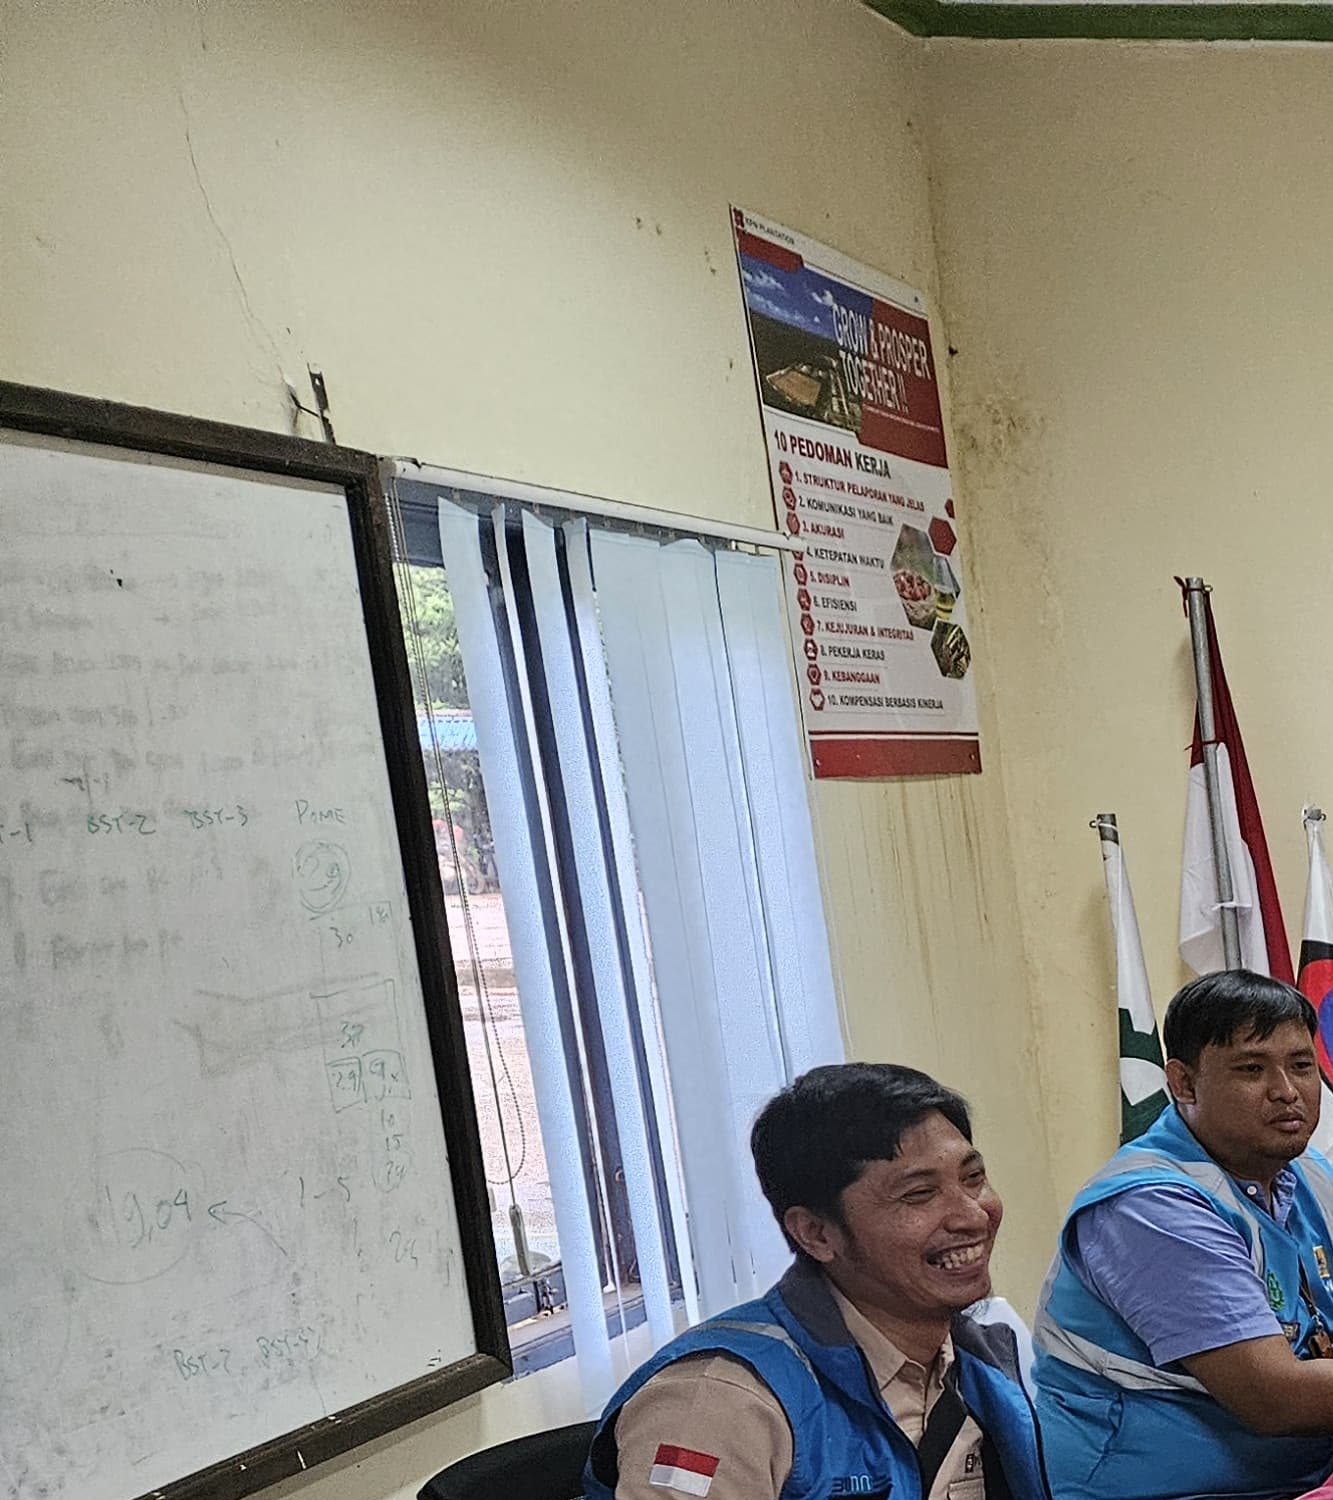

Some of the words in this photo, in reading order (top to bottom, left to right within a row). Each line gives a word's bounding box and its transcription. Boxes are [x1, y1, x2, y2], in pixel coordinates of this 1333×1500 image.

[832, 303, 868, 356] GROW
[878, 323, 932, 381] PROSPER
[839, 349, 902, 412] TOGETHER
[774, 429, 788, 452] 10
[790, 433, 853, 468] PEDOMAN
[854, 451, 892, 480] KERJA
[803, 472, 846, 492] STRUKTUR
[847, 482, 890, 503] PELAPORAN
[807, 497, 857, 517] KOMUNIKASI
[810, 522, 845, 540] AKURASI
[814, 547, 859, 564] KETEPATAN
[817, 572, 850, 587] DISIPLIN
[821, 596, 858, 612] EFISIENSI
